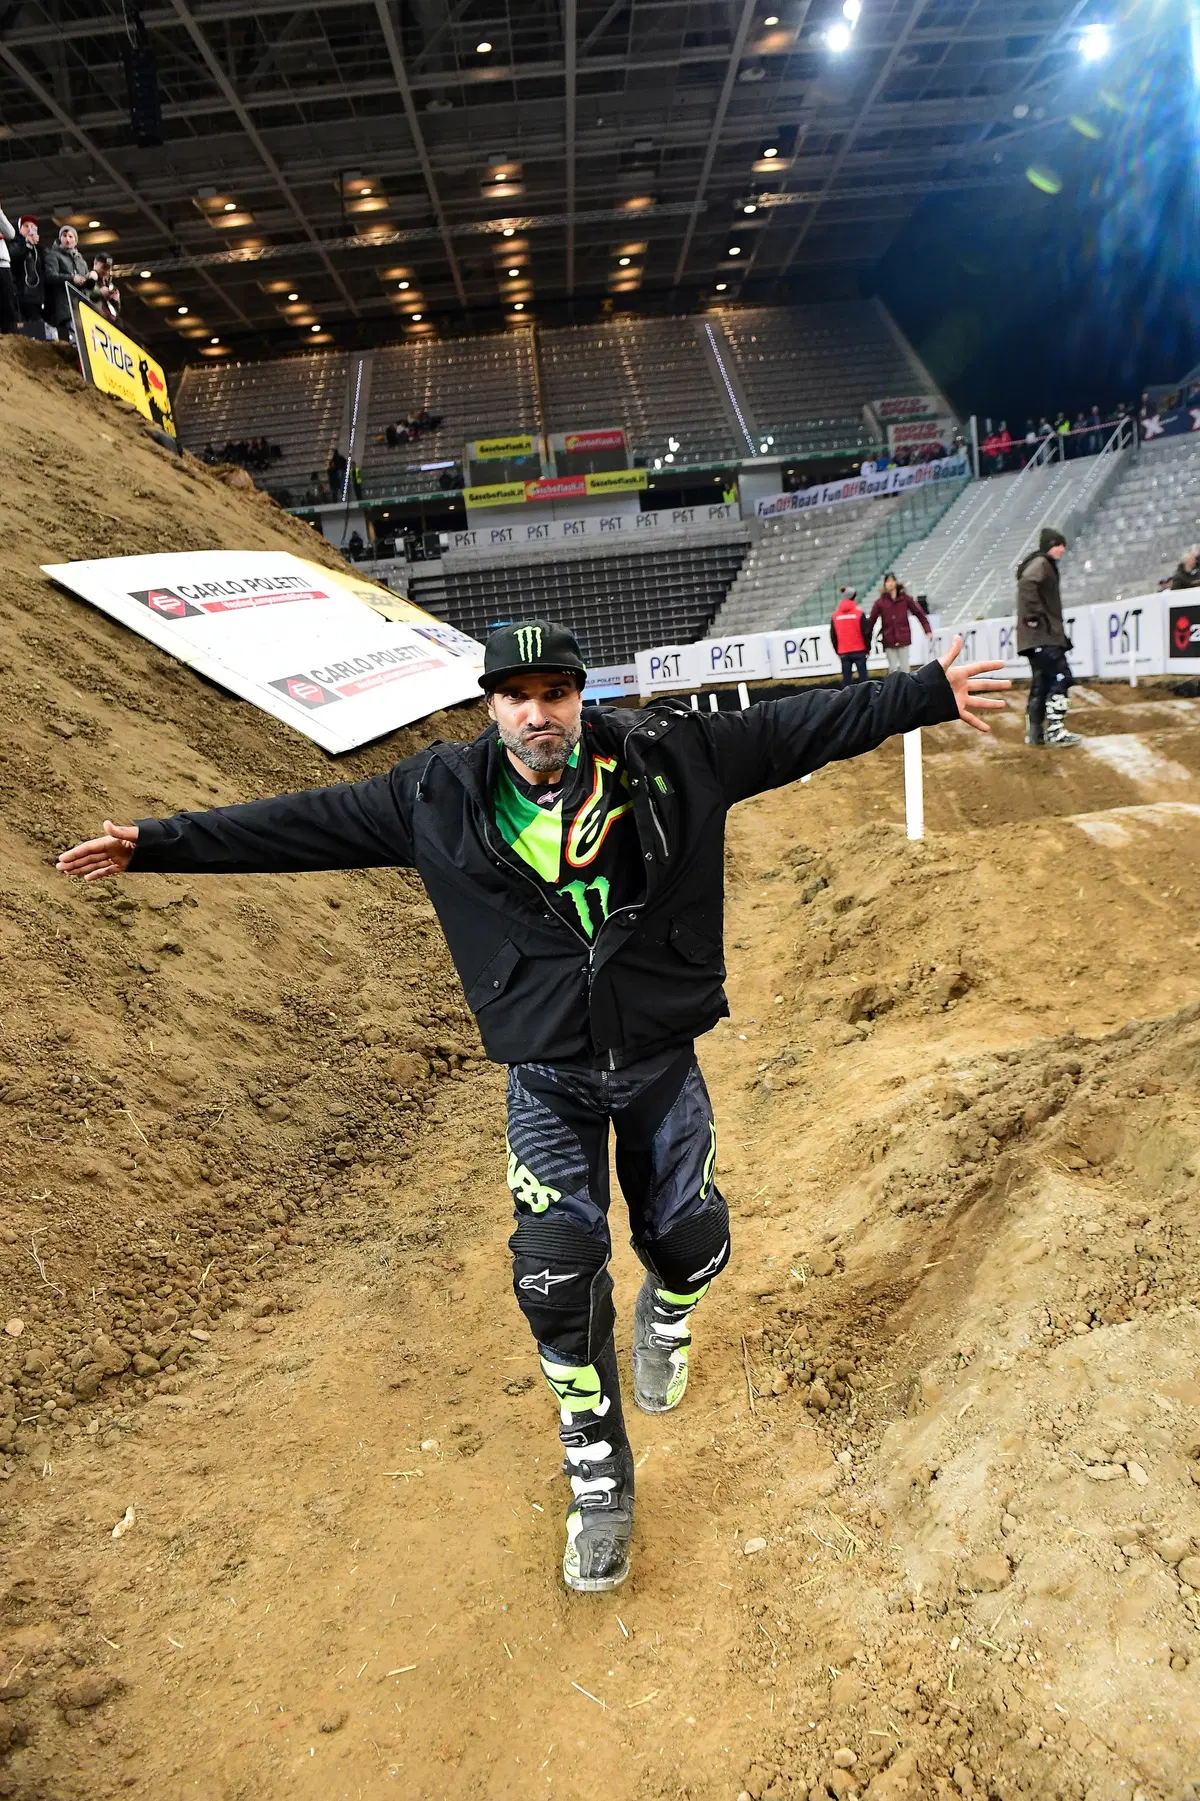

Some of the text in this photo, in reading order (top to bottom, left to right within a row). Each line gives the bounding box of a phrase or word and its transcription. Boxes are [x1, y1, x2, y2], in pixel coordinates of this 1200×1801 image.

[177, 576, 312, 599] CARLO POLETTI
[1108, 609, 1143, 656] PKT
[310, 657, 375, 684] CARLO
[368, 645, 430, 667] POLETTI
[711, 643, 745, 670] PKT
[784, 636, 821, 665] PKT
[650, 654, 681, 679] PKT
